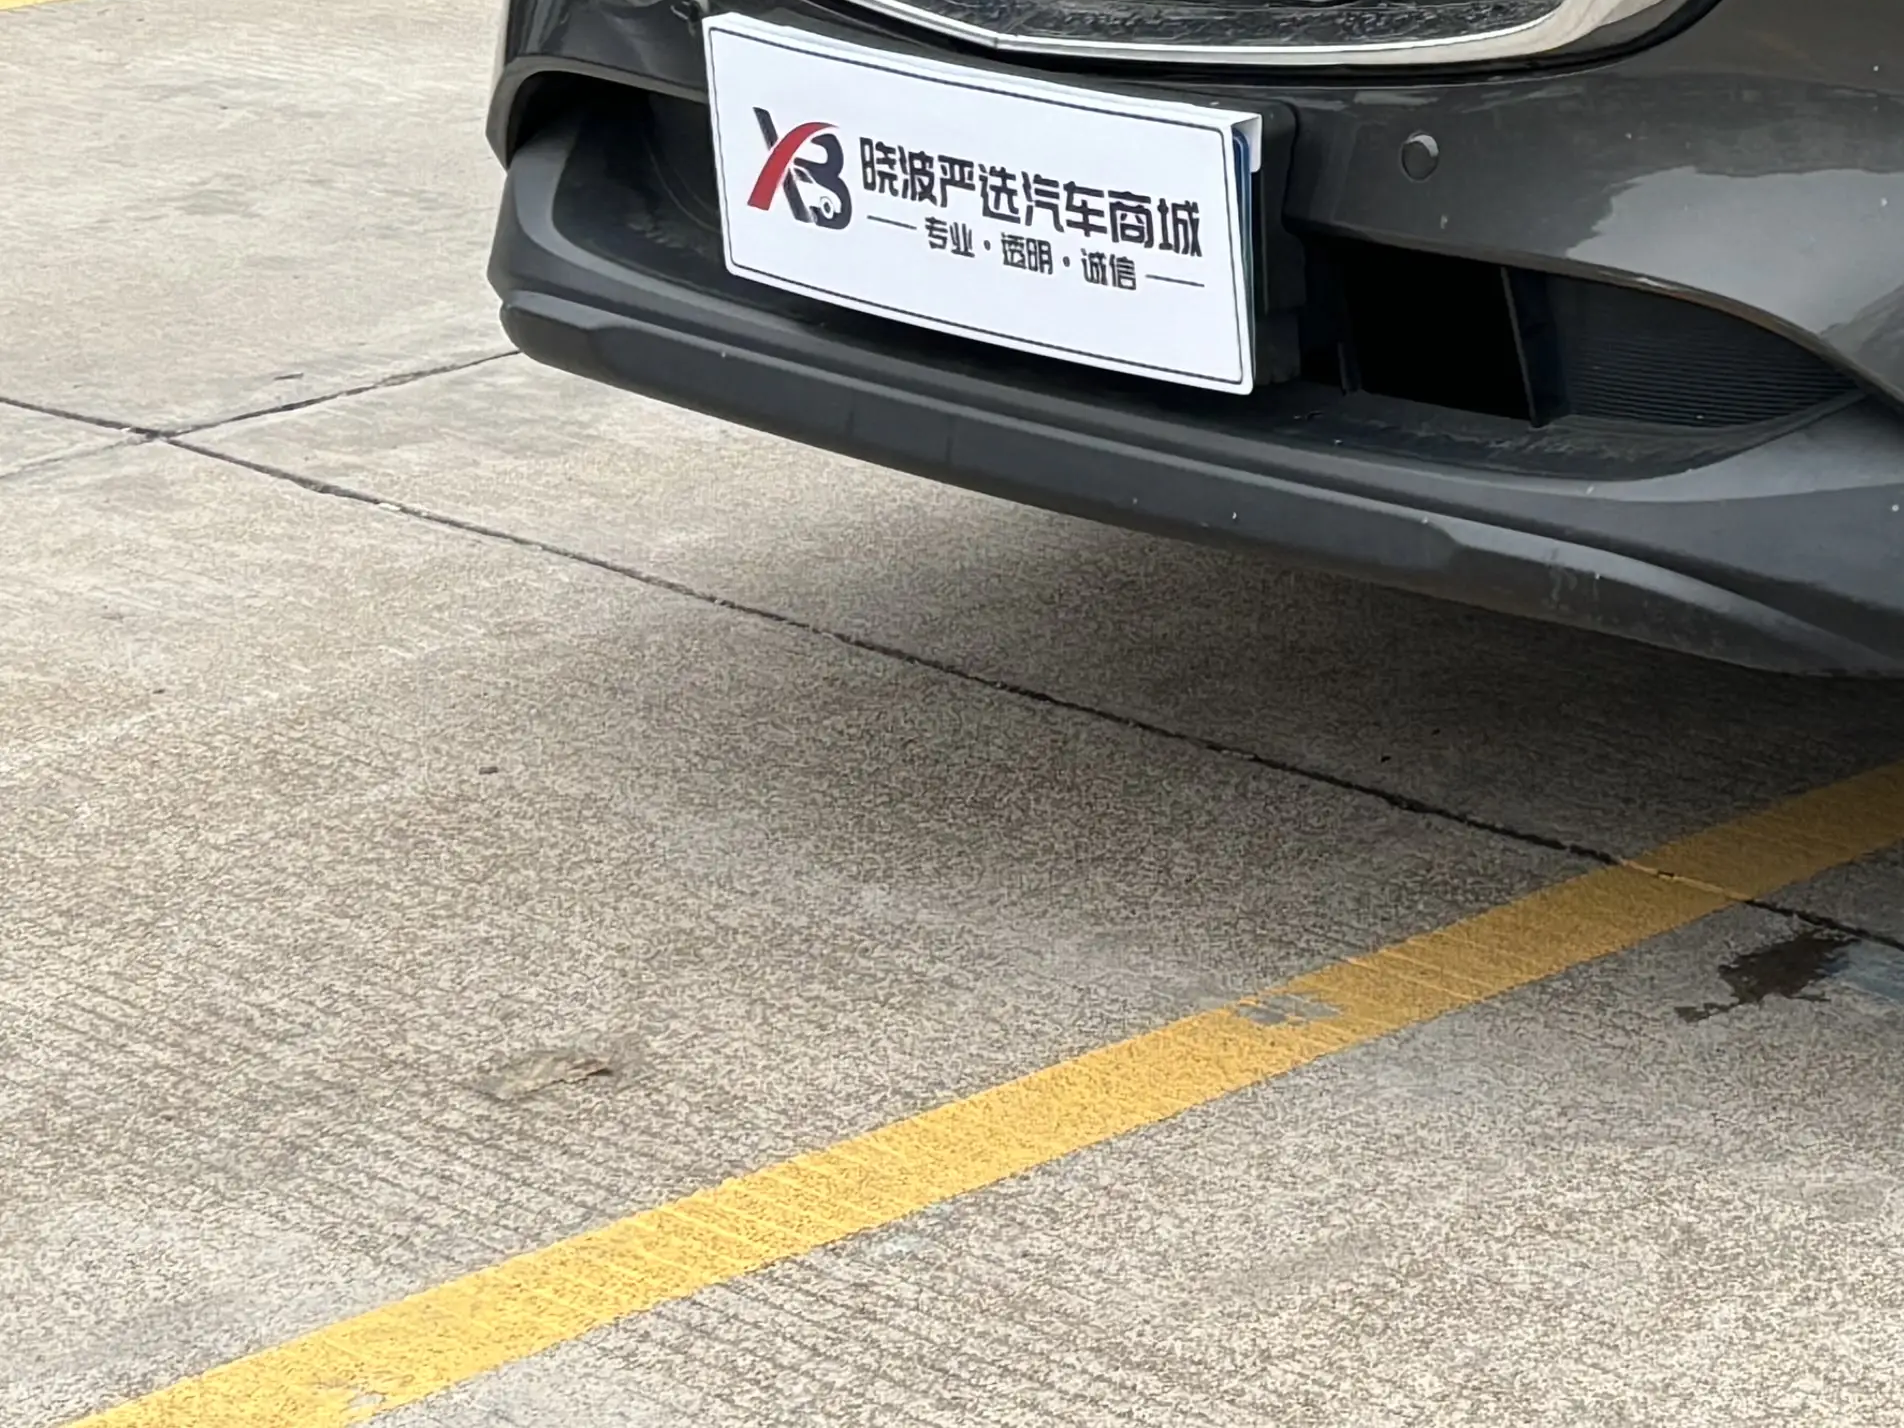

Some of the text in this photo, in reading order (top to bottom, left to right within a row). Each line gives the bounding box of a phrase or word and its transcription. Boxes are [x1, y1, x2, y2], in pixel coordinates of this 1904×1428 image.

[860, 135, 1203, 258] 晓波严选汽车商城
